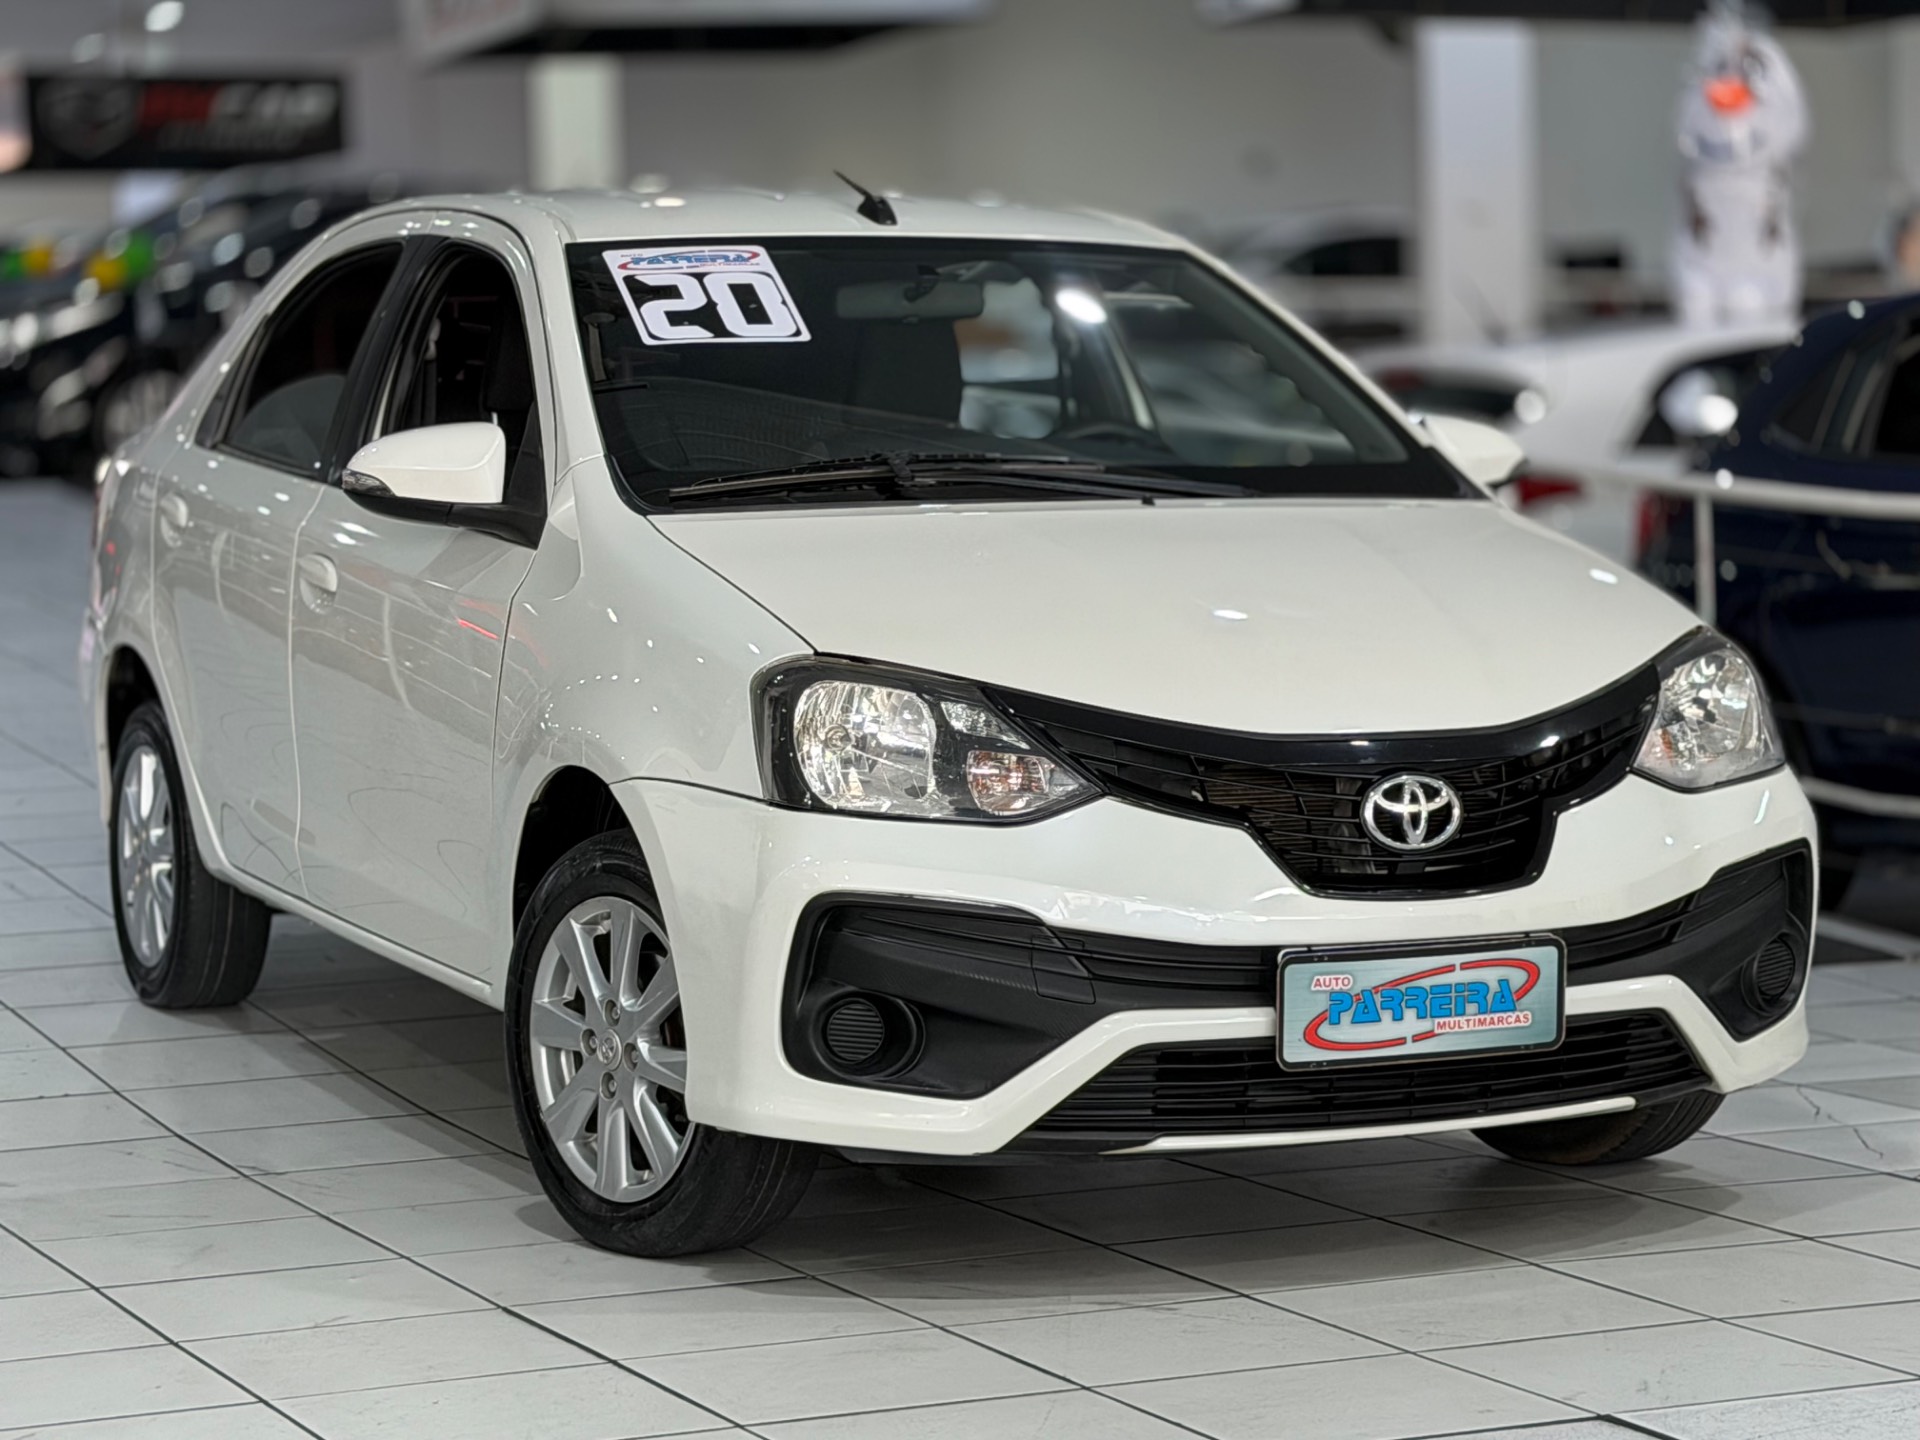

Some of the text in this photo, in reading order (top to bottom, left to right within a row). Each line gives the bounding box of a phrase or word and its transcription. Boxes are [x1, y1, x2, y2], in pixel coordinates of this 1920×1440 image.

[633, 272, 797, 340] 20
[1313, 975, 1351, 989] AUTO
[1328, 979, 1517, 1025] PARREIRA
[1436, 1013, 1530, 1031] MULTIMARCAS
